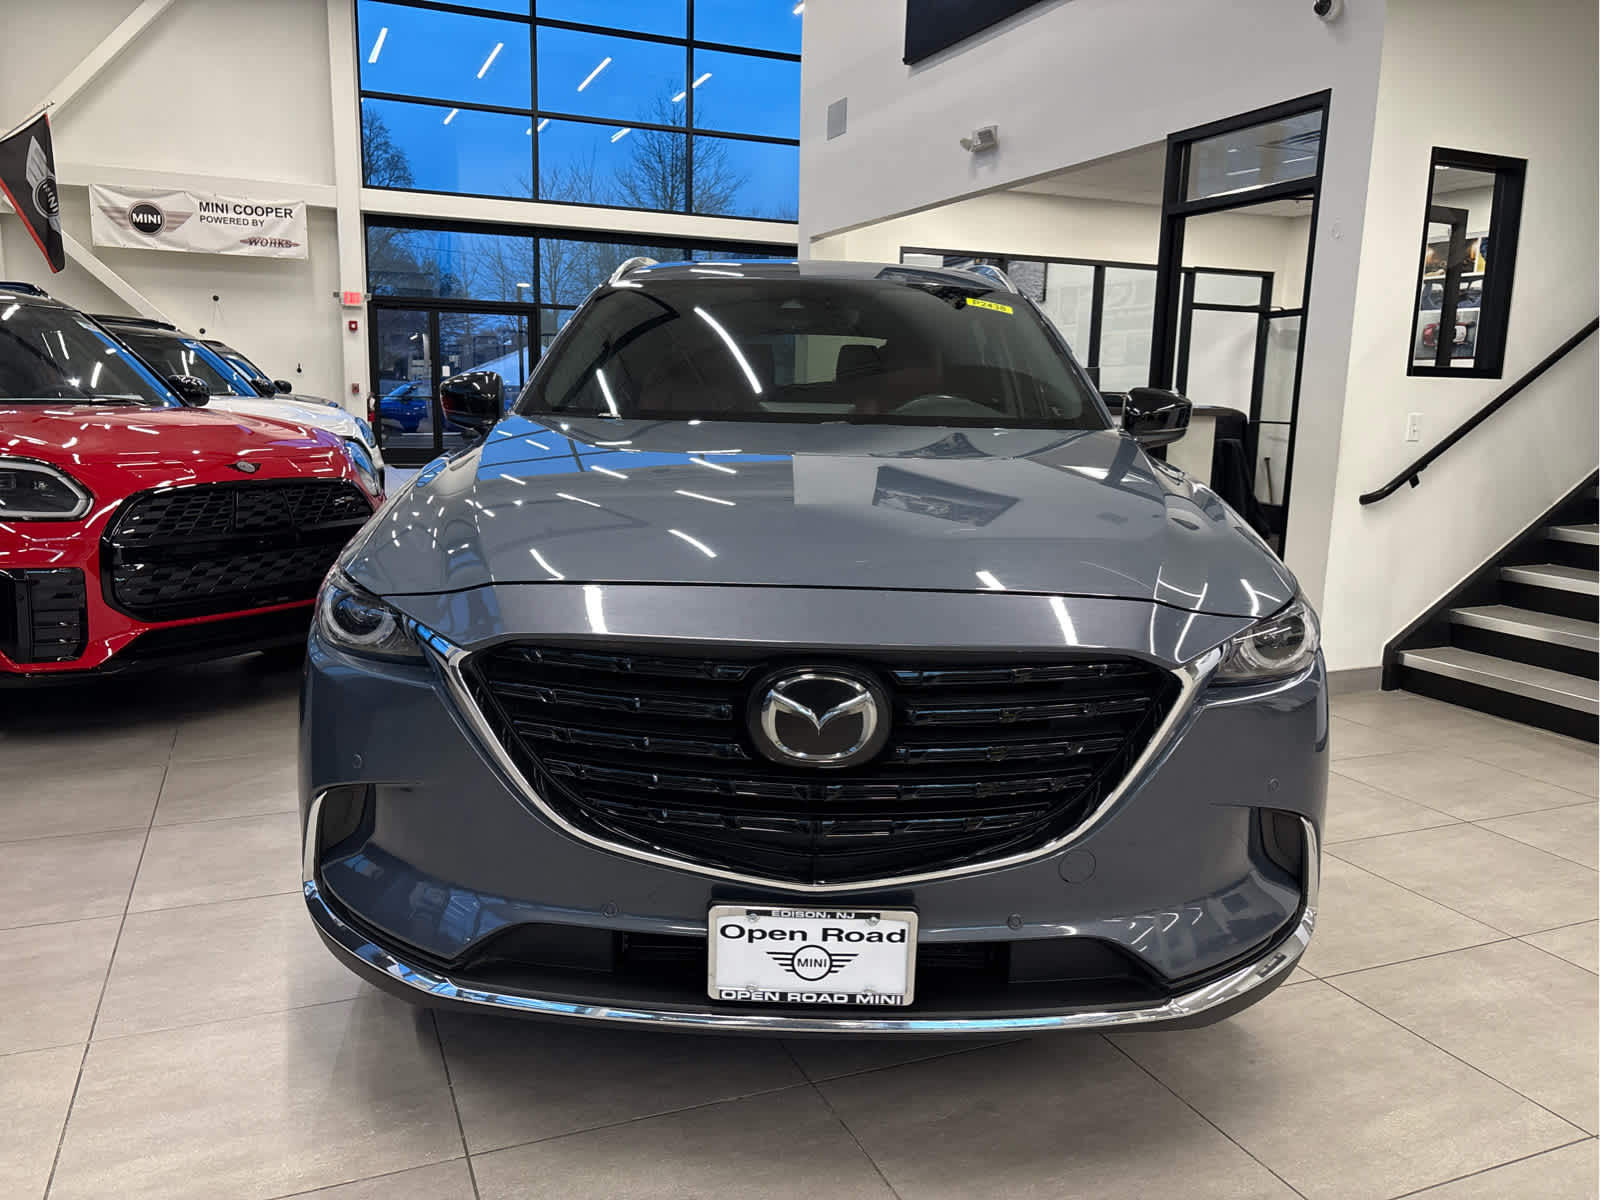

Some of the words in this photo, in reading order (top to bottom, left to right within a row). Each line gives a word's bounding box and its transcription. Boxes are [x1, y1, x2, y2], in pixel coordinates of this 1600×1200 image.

[199, 202, 229, 214] MINI
[233, 204, 293, 219] COOPER
[131, 213, 161, 225] MINI
[200, 215, 249, 227] POWERED
[252, 218, 265, 228] BY
[771, 910, 831, 919] EDISON,
[836, 911, 855, 919] NJ
[719, 924, 808, 943] Open
[822, 927, 906, 943] Road
[797, 958, 828, 968] MINI
[721, 990, 780, 1001] OPEN
[787, 992, 848, 1004] ROAD
[856, 993, 901, 1005] MINI
